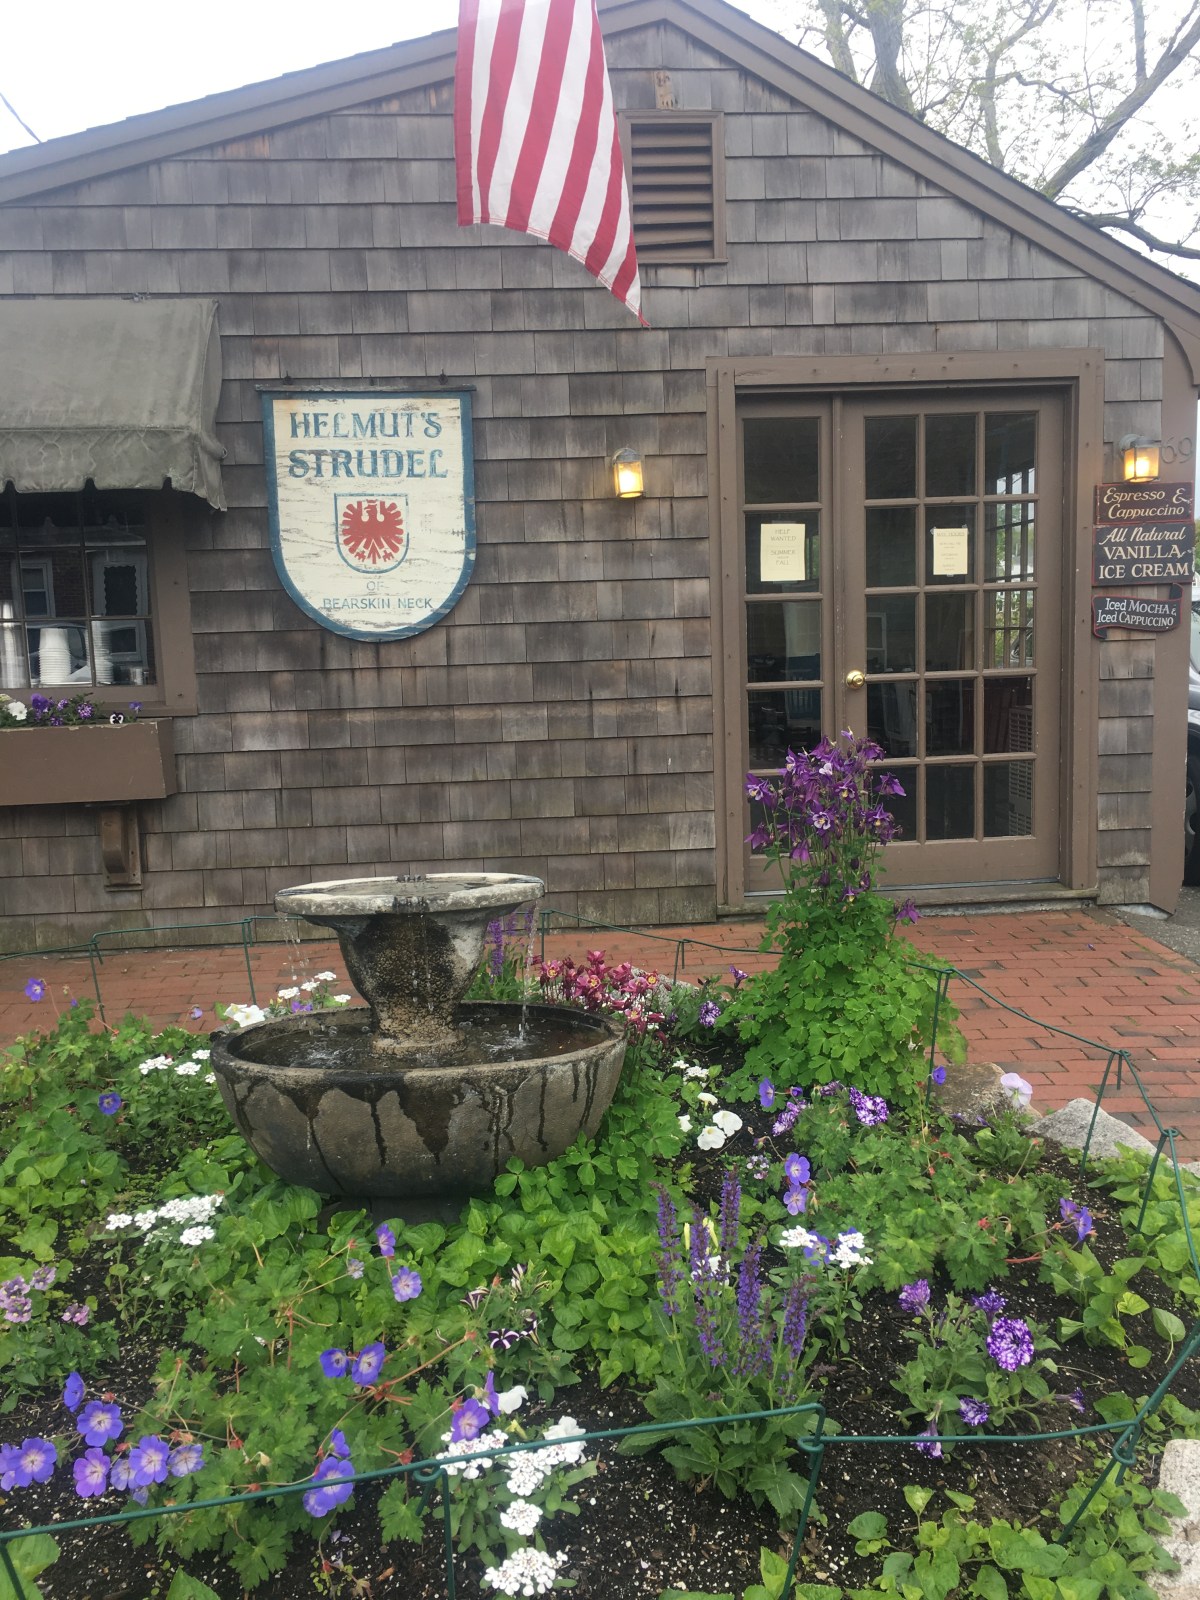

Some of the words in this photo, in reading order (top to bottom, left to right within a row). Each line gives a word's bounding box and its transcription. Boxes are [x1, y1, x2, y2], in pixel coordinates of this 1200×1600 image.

[289, 411, 442, 439] HELMUT'S
[1161, 436, 1194, 464] 69
[288, 448, 449, 479] STRUDEL
[1103, 487, 1166, 504] Espresso
[1172, 487, 1190, 504] &
[1108, 503, 1185, 519] Cappuccino
[1099, 527, 1129, 545] All
[1130, 526, 1186, 542] Natural
[1103, 544, 1182, 560] VANILLA
[1098, 564, 1126, 579] ICE
[1131, 562, 1190, 578] CREAM
[366, 581, 385, 591] OF
[322, 597, 390, 609] BEARSKIN
[398, 597, 433, 609] NECK
[1105, 598, 1127, 611] Iced
[1128, 600, 1170, 615] MOCHA
[1097, 609, 1118, 623] Iced
[1118, 612, 1174, 627] CAPPUCCINO
